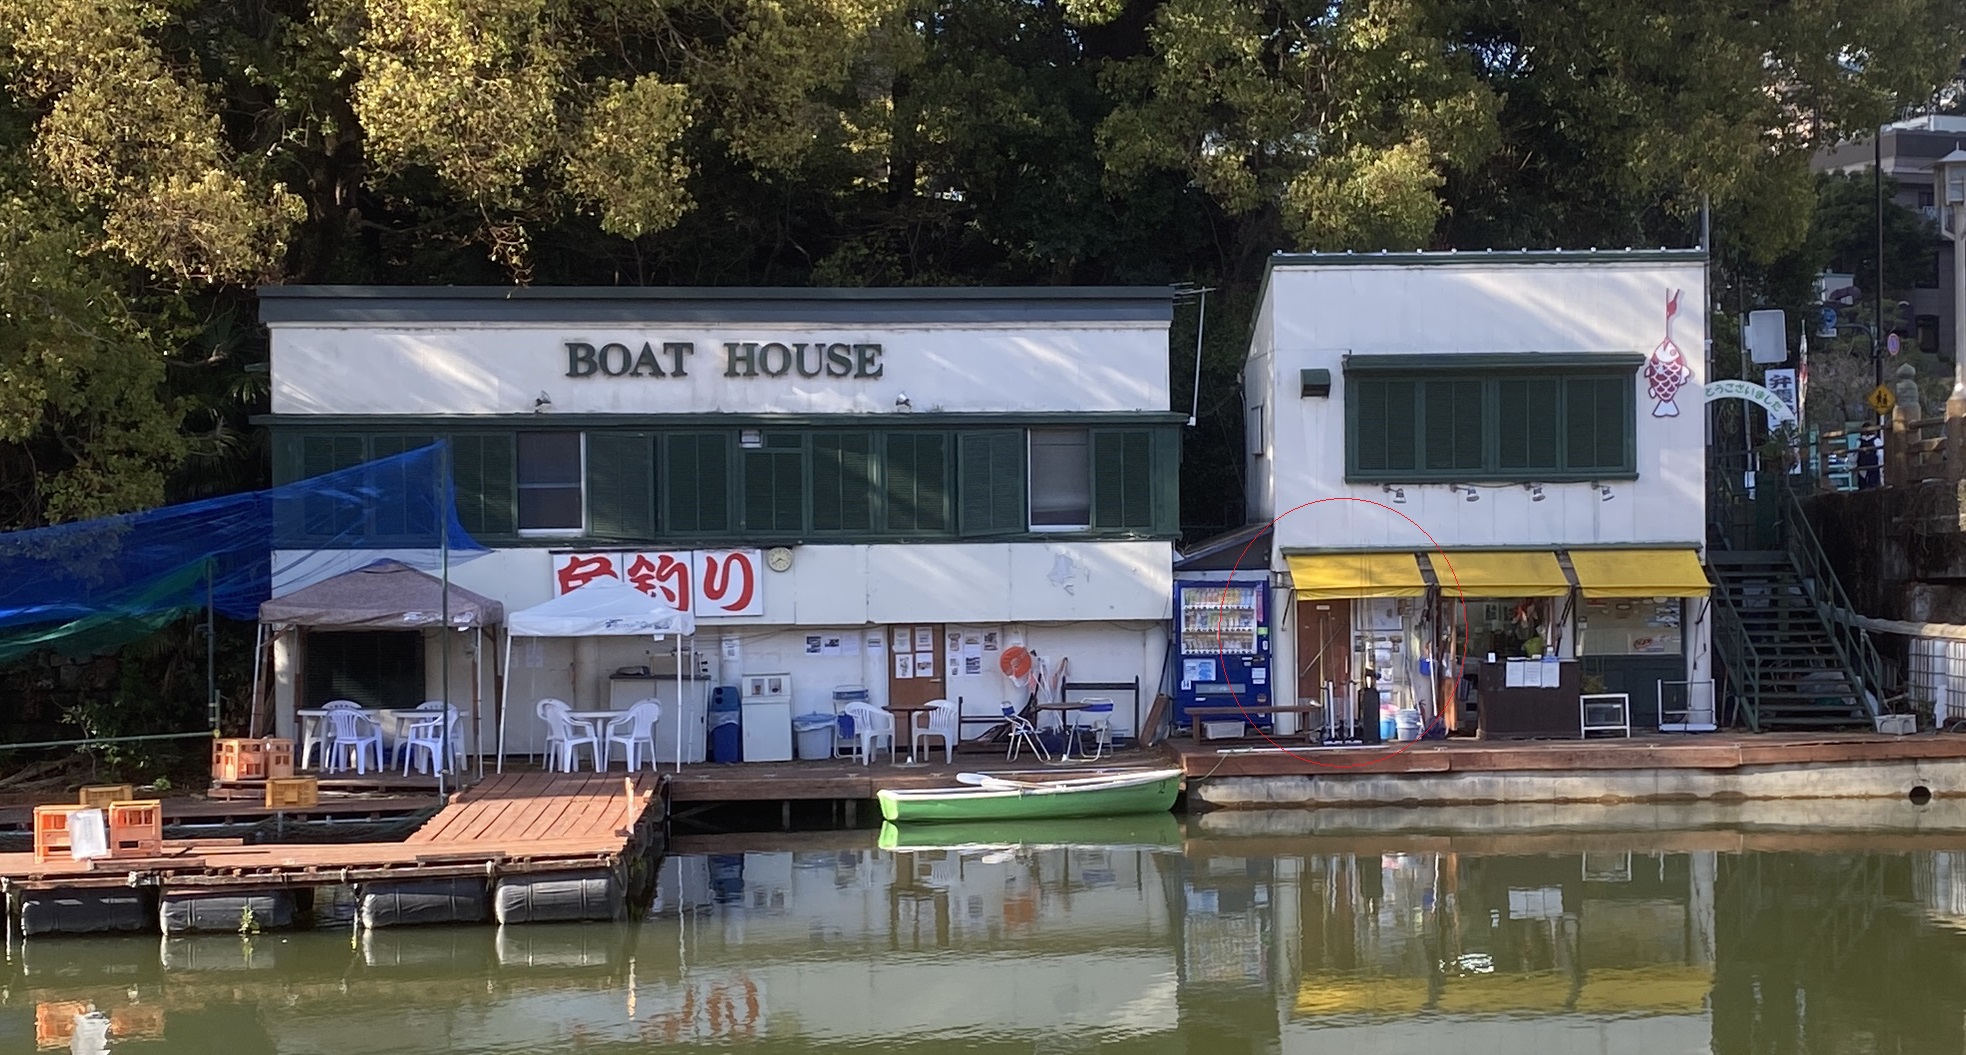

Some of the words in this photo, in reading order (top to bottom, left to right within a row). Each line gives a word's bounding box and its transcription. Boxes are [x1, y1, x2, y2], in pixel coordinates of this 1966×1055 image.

[564, 341, 694, 377] BOAT
[723, 342, 884, 379] HOUSE
[1158, 779, 1166, 795] 2
